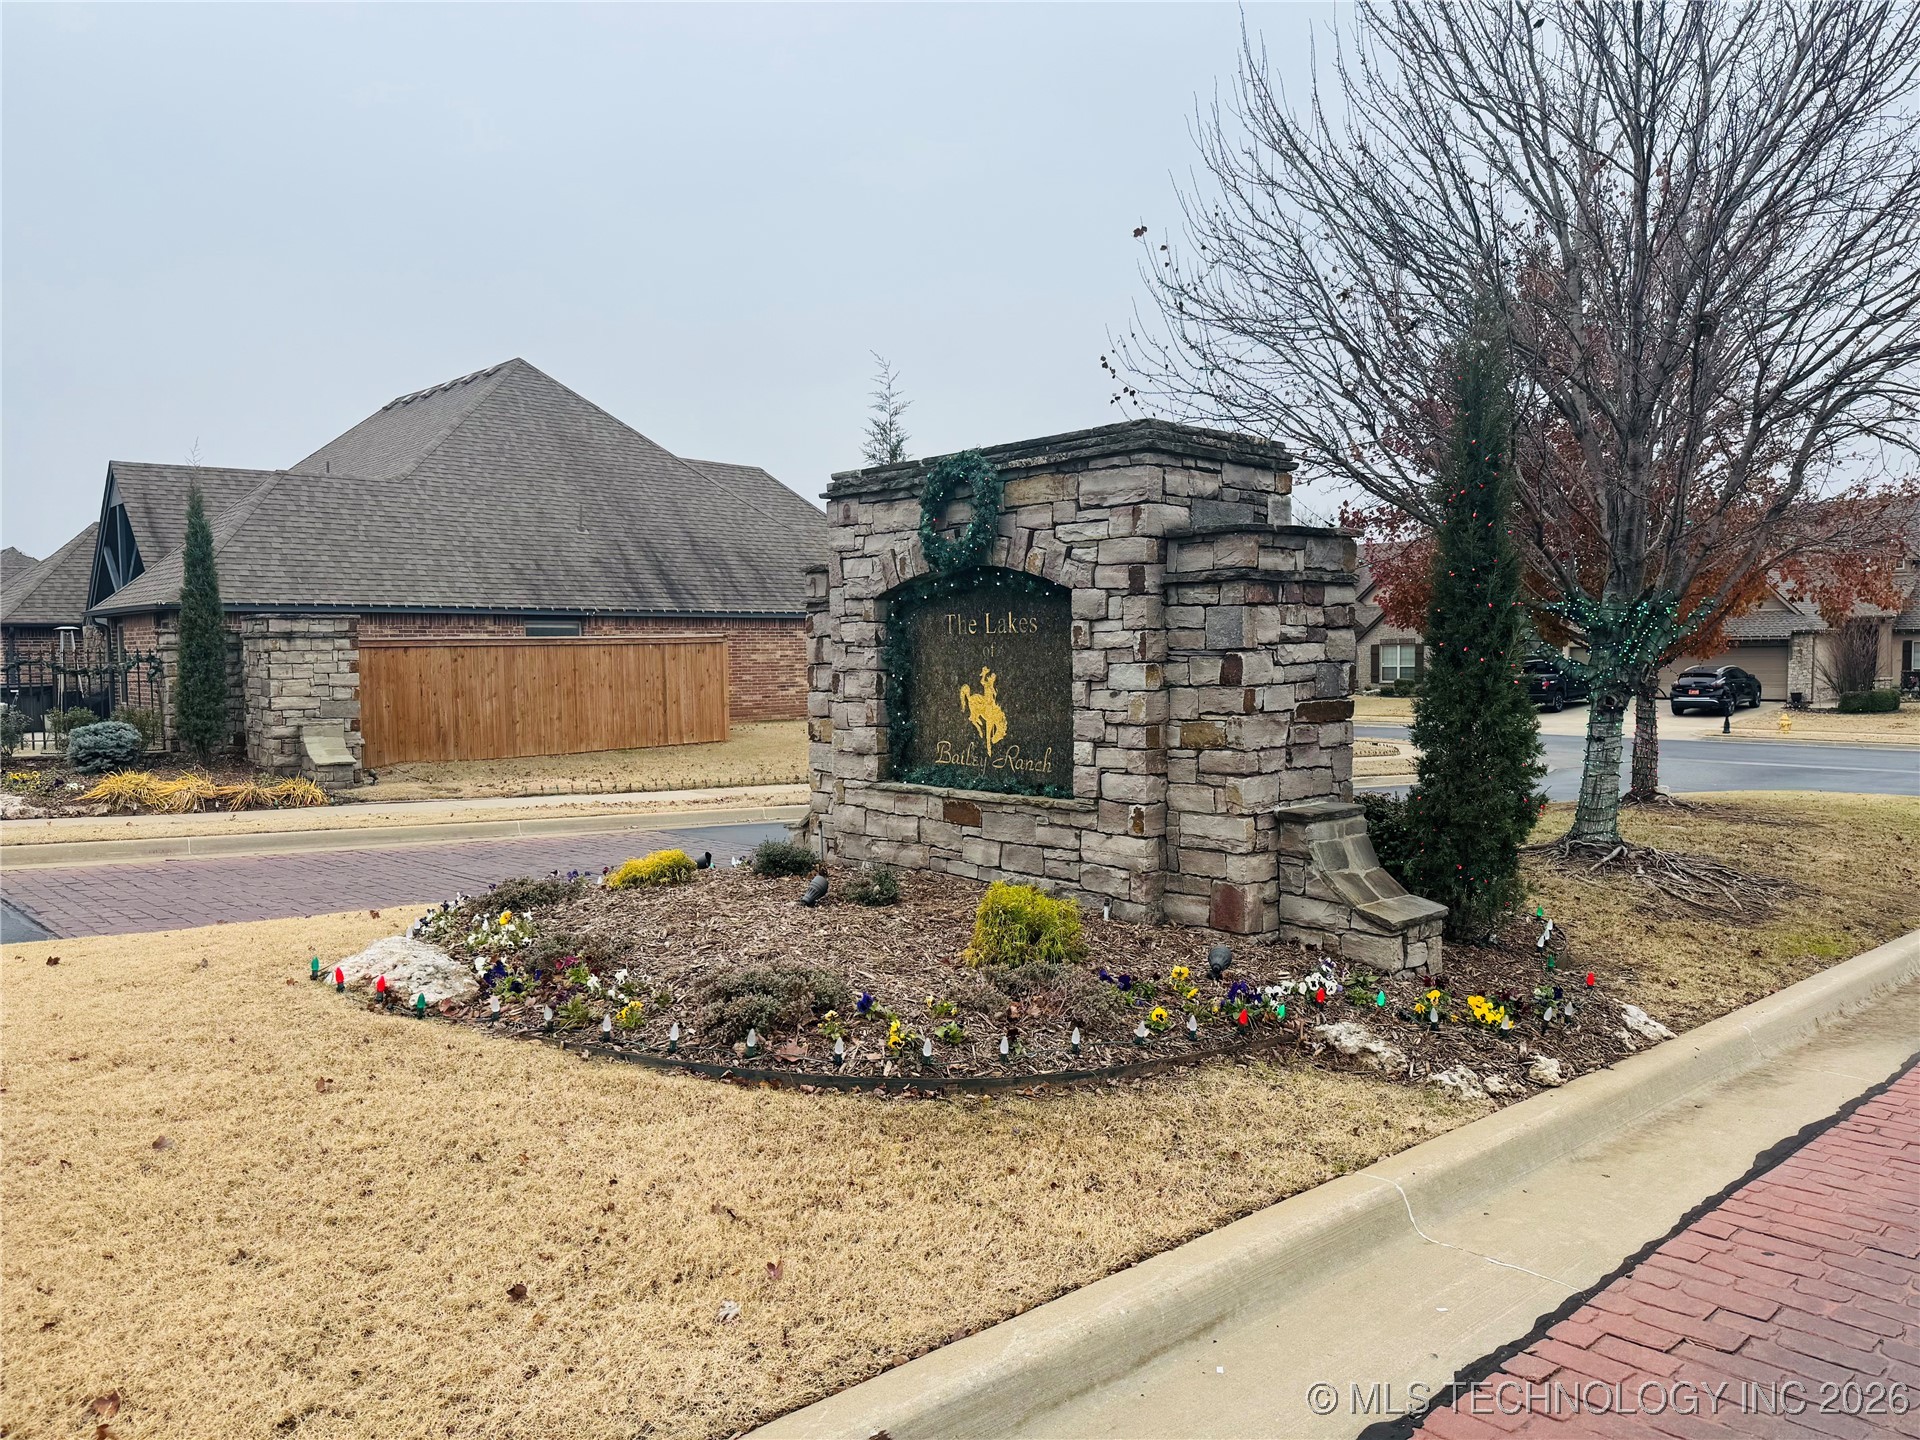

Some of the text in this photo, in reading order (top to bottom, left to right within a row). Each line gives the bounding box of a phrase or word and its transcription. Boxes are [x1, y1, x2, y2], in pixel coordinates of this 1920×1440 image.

[946, 612, 1038, 635] The Lakes
[982, 642, 997, 657] of
[935, 740, 1052, 776] Bailey Ranch
